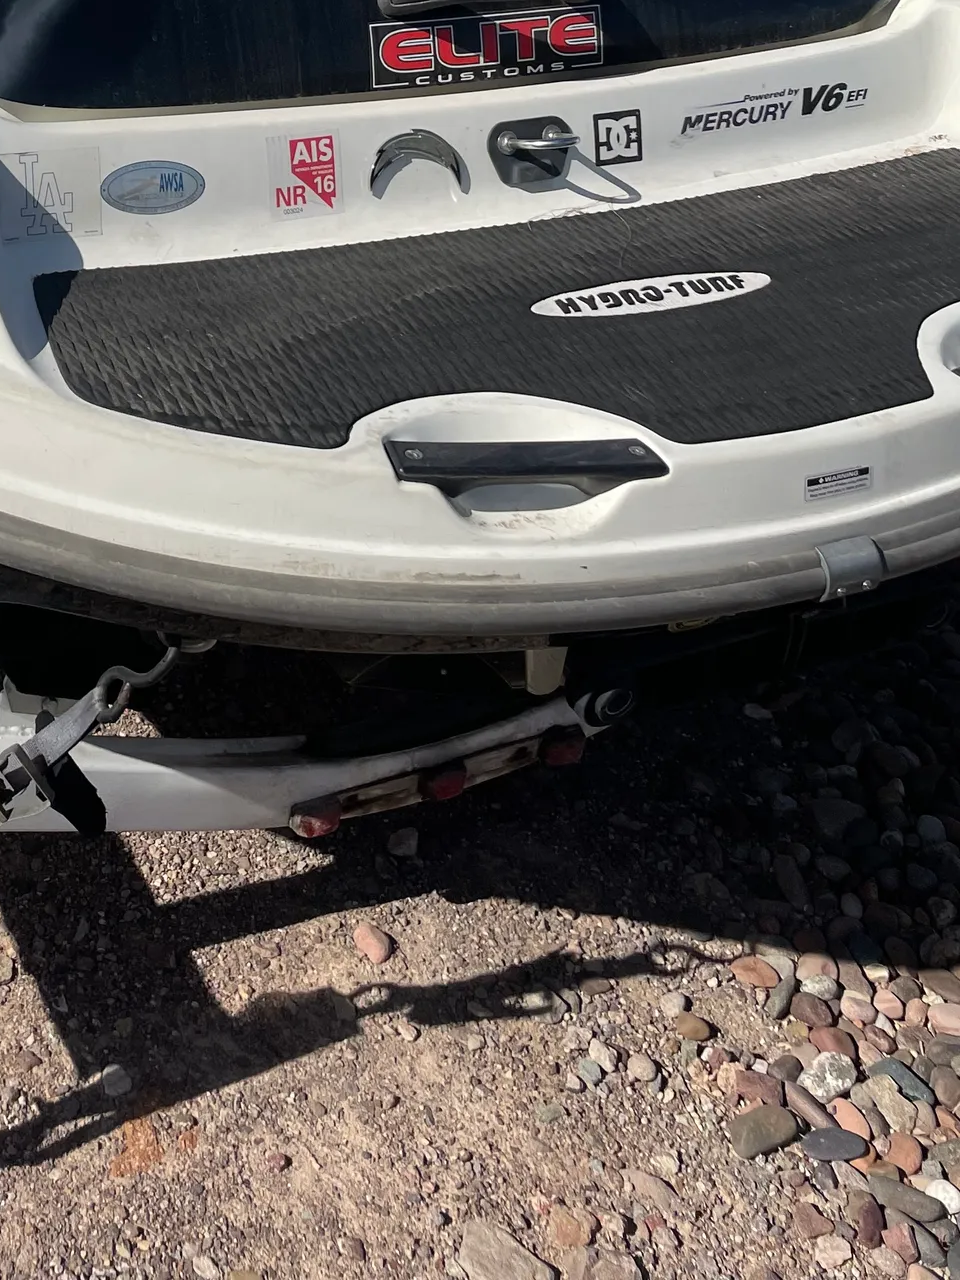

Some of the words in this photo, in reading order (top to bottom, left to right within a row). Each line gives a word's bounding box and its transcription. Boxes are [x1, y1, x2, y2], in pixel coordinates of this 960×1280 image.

[379, 11, 598, 73] ELITE
[414, 61, 565, 86] CUSTOMS
[680, 100, 793, 135] MERCURY
[801, 82, 849, 116] V6
[846, 88, 869, 103] EFI
[743, 88, 786, 103] Powered
[787, 87, 800, 98] by
[595, 112, 640, 163] DC
[292, 137, 333, 166] AIS
[18, 153, 74, 237] LA
[159, 172, 185, 193] AWSA
[313, 174, 335, 194] 16
[275, 184, 307, 209] NR
[554, 273, 745, 315] HYDRO-TURF
[824, 470, 859, 483] WARNING
